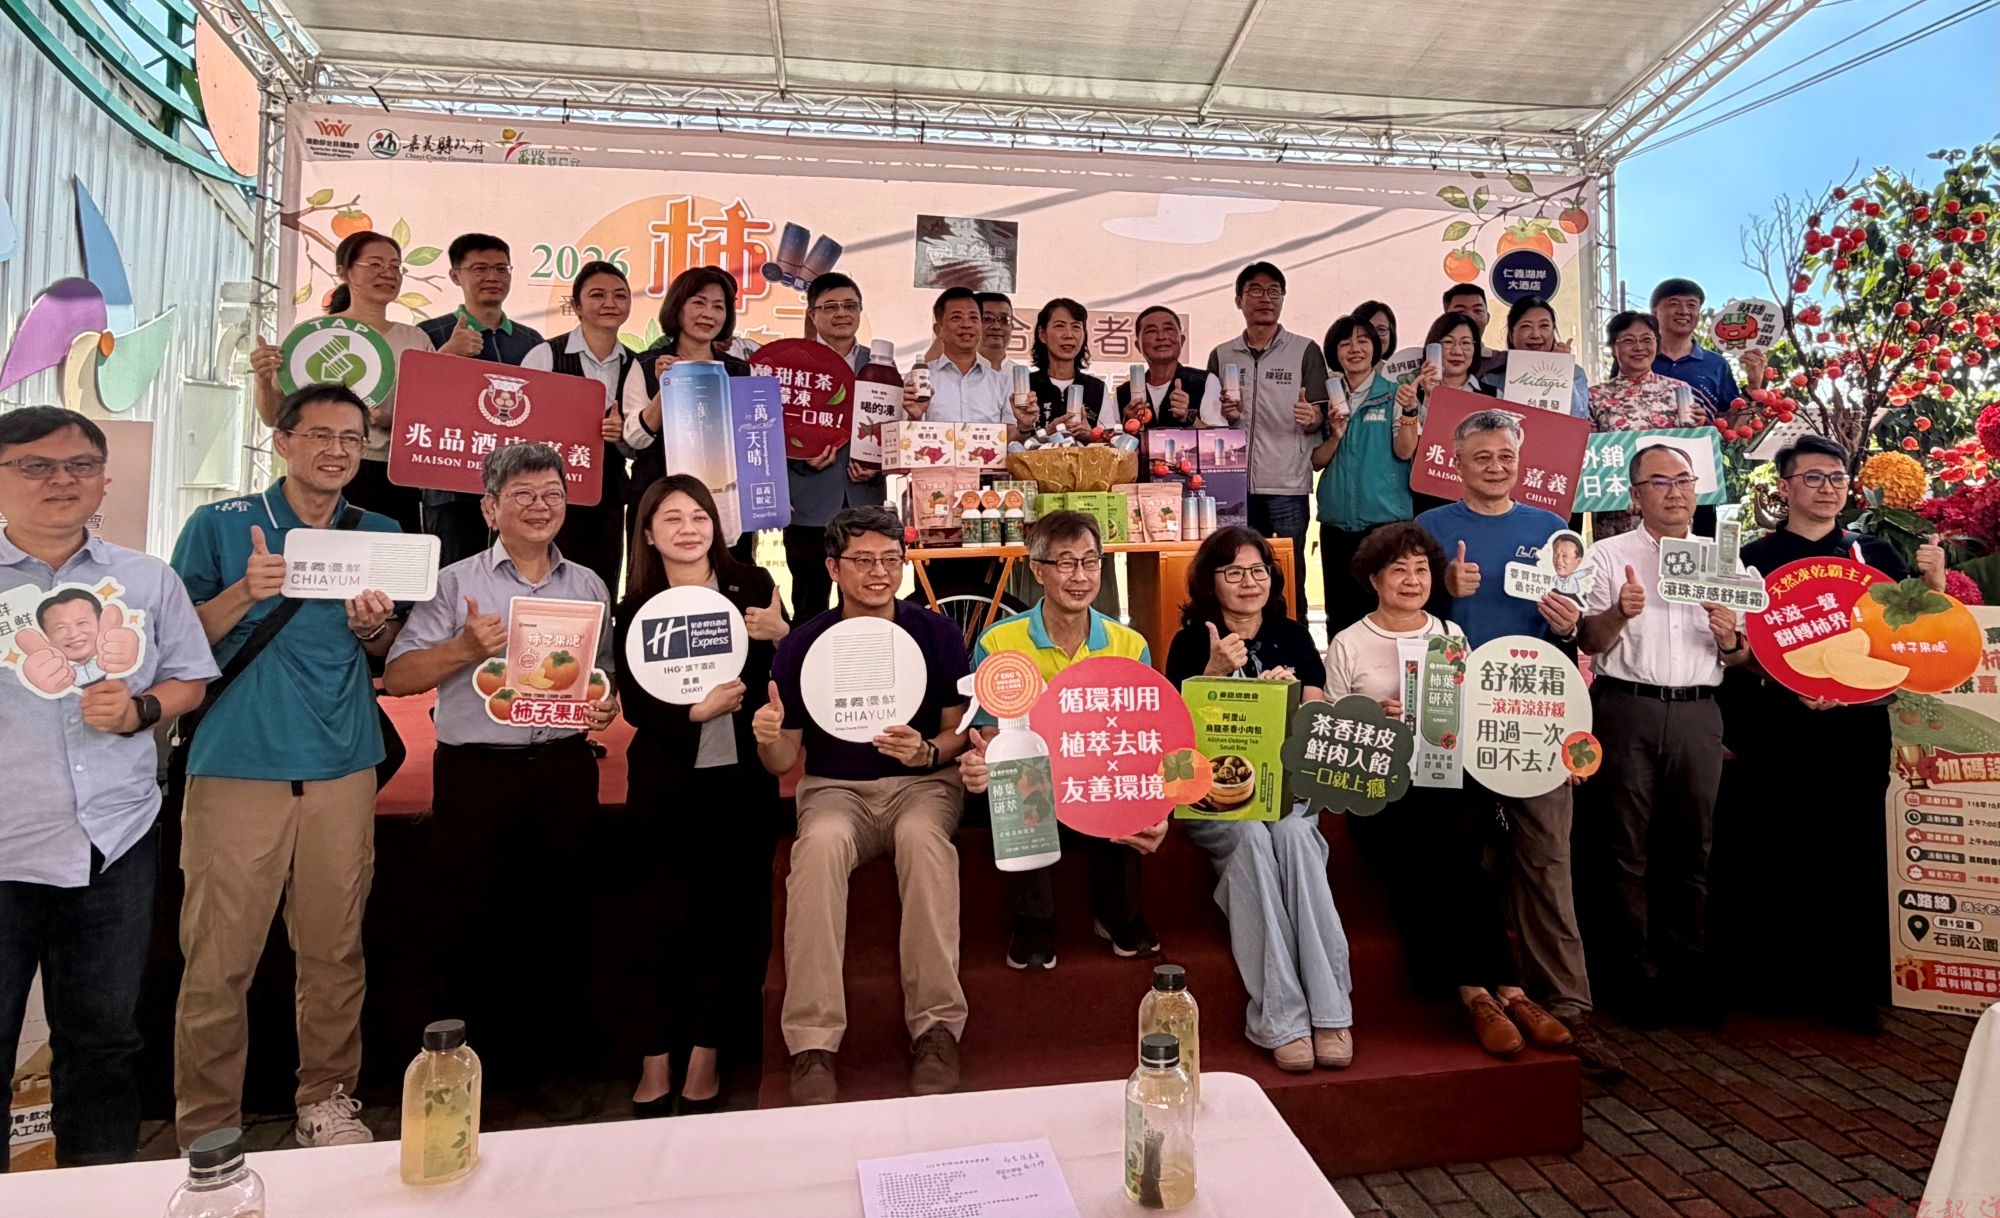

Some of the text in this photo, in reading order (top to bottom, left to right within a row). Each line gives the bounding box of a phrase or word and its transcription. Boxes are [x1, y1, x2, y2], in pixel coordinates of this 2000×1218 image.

[1507, 280, 1542, 292] 大酒店
[308, 317, 371, 333] TAP
[860, 401, 896, 417] 喝的凍
[411, 454, 462, 468] MAISON
[1583, 474, 1628, 498] 日本
[1525, 491, 1558, 506] CHIAYI
[291, 573, 360, 586] CHIAYUM
[1663, 581, 1763, 607] 滾珠涼感舒緩霜
[691, 628, 718, 637] Holiday
[691, 635, 729, 649] Express
[1480, 661, 1566, 696] 舒緩霜
[1058, 686, 1160, 714] 循環利用
[835, 708, 897, 723] CHIAYUM
[1311, 713, 1398, 752] 茶香揉皮
[1476, 719, 1566, 747] 用過一次
[1060, 730, 1163, 759] 植萃去味
[1304, 737, 1392, 776] 鮮肉入餡
[1061, 774, 1166, 804] 友善環境
[1300, 767, 1388, 800] 一口就上癮
[1904, 893, 1951, 911] A路線
[1933, 932, 1998, 953] 石頭公園
